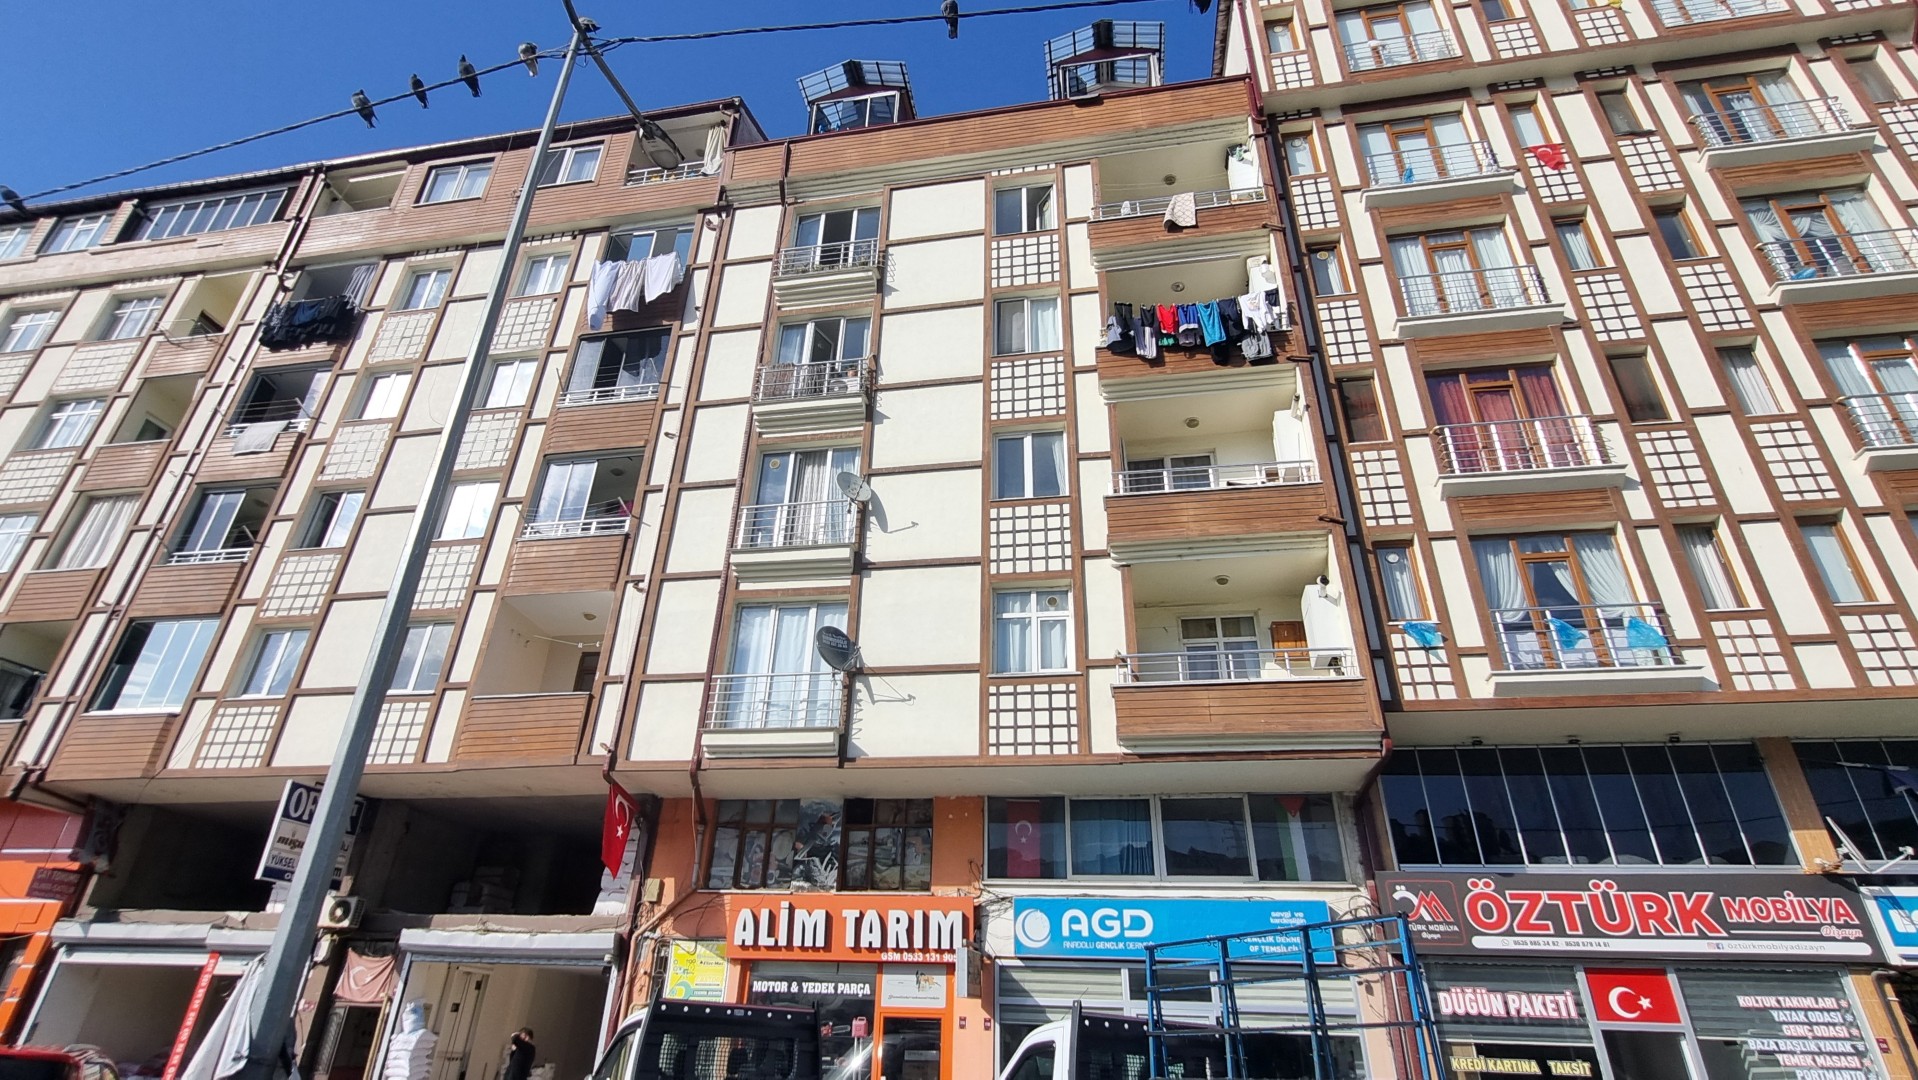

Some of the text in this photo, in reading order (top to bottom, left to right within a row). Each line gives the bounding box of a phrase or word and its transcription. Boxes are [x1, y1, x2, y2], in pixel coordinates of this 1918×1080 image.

[1464, 878, 1729, 936] ÖZTÜRK
[1719, 890, 1860, 924] MOBİLYA
[734, 901, 963, 949] ALİM TARIM
[1061, 907, 1154, 938] AGD
[1408, 922, 1428, 932] TÜRK
[1820, 925, 1863, 939] Dizayn
[1063, 940, 1095, 949] ANADOLU
[1249, 945, 1260, 953] OF
[1727, 942, 1826, 952] öztürkmobilyadizayn
[881, 952, 901, 961] GSM
[903, 952, 923, 961] 0533
[925, 953, 940, 962] 131
[753, 980, 871, 997] MOTOR & YEDEK PARÇA
[1438, 987, 1578, 1018] DÜĞÜN PAKETİ
[1737, 995, 1840, 1010] KOLTUK TAKIMLARI
[1770, 1010, 1844, 1023] YATAK ODASI
[1782, 1024, 1850, 1039] GENÇ ODASI
[1748, 1039, 1856, 1054] BAZA BAŞLIK YATAK
[1451, 1055, 1592, 1076] KREDİ KARTINA TAKSİT
[1775, 1053, 1863, 1069] YEMEK MASASI
[1795, 1070, 1866, 1080] PORTMANTO
